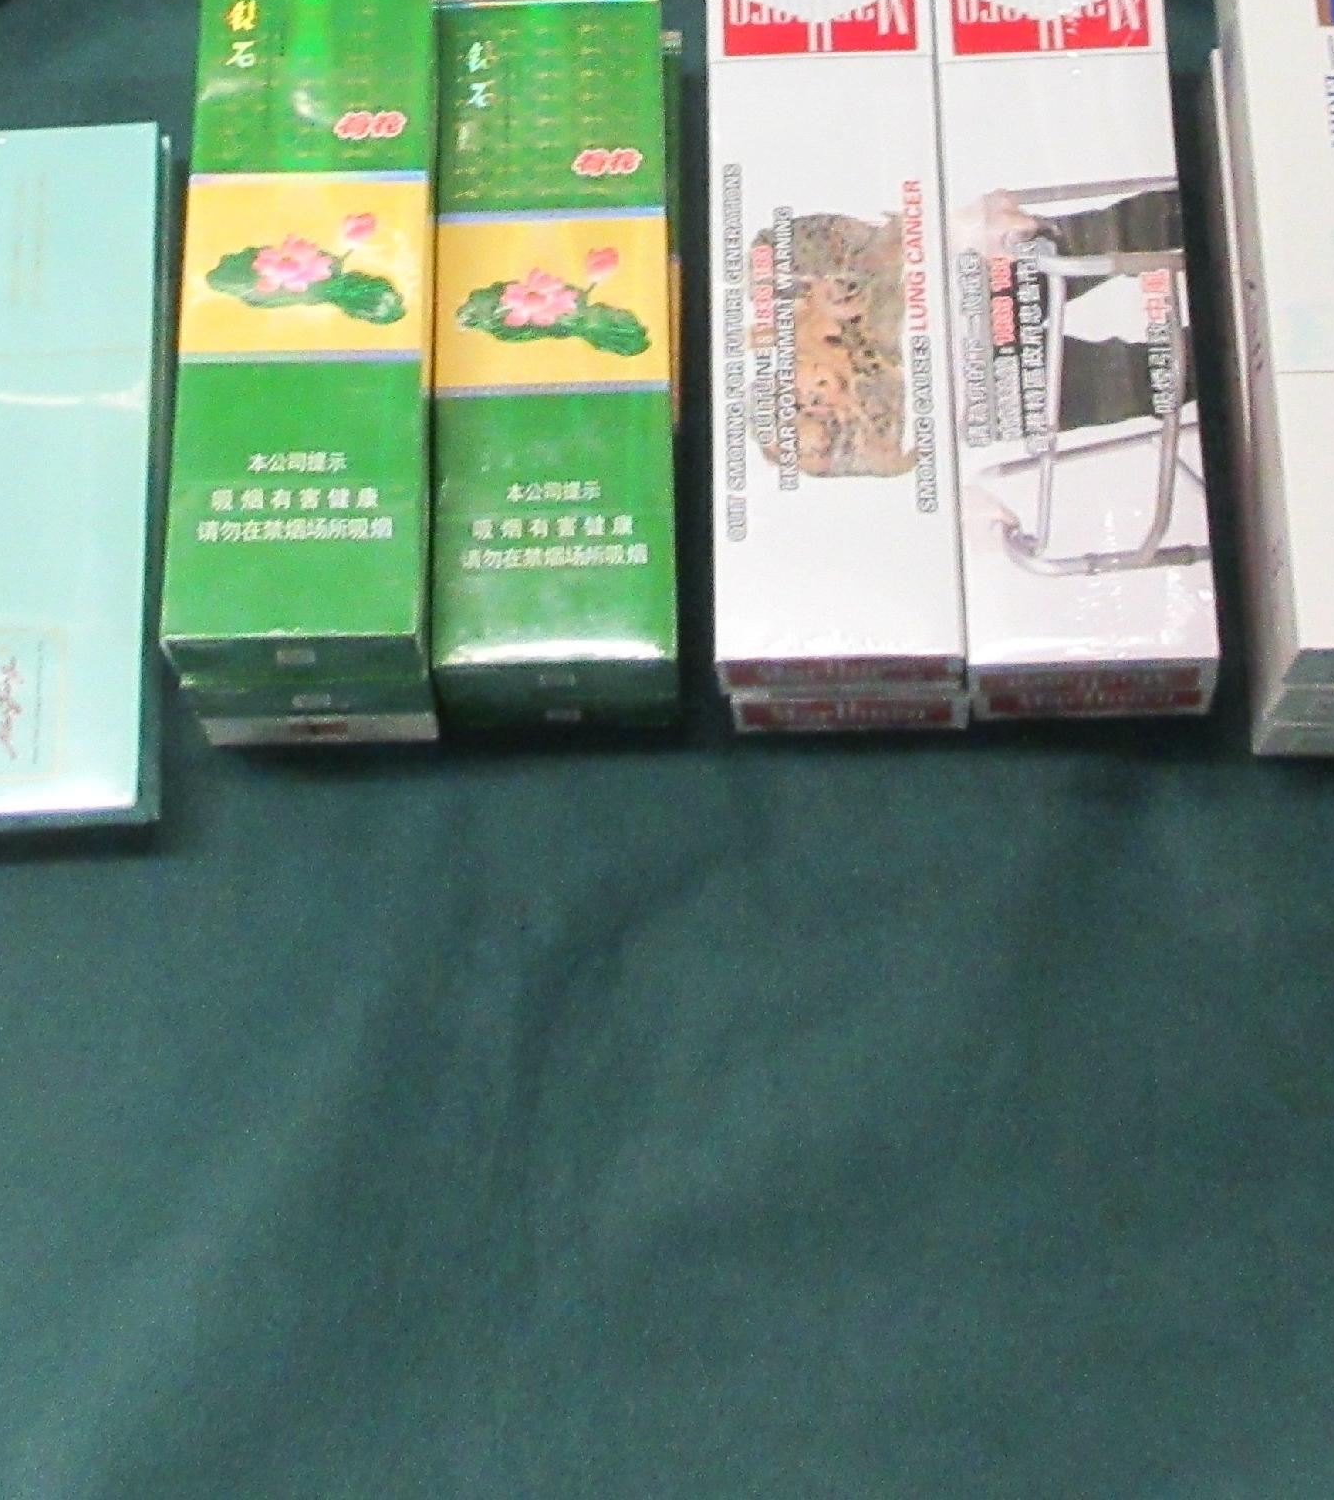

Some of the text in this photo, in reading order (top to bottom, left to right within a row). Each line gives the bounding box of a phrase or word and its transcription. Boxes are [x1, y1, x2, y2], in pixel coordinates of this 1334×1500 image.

[772, 206, 794, 290] WARNING
[722, 163, 747, 542] QUIT SMOKING FOR FUTURE GENERATIONS
[775, 298, 798, 419] GOVERNMENT
[902, 180, 939, 513] SMOKING CAUSES LUNG CANCER
[247, 451, 348, 474] 本公司提示
[210, 486, 380, 512] 吸烟有害健康
[505, 480, 602, 503] 本公司提示
[195, 516, 394, 543] 请勿在禁烟场所吸烟
[471, 514, 635, 540] 吸烟有害健康
[462, 542, 650, 570] 请勿在禁烟场所吸烟
